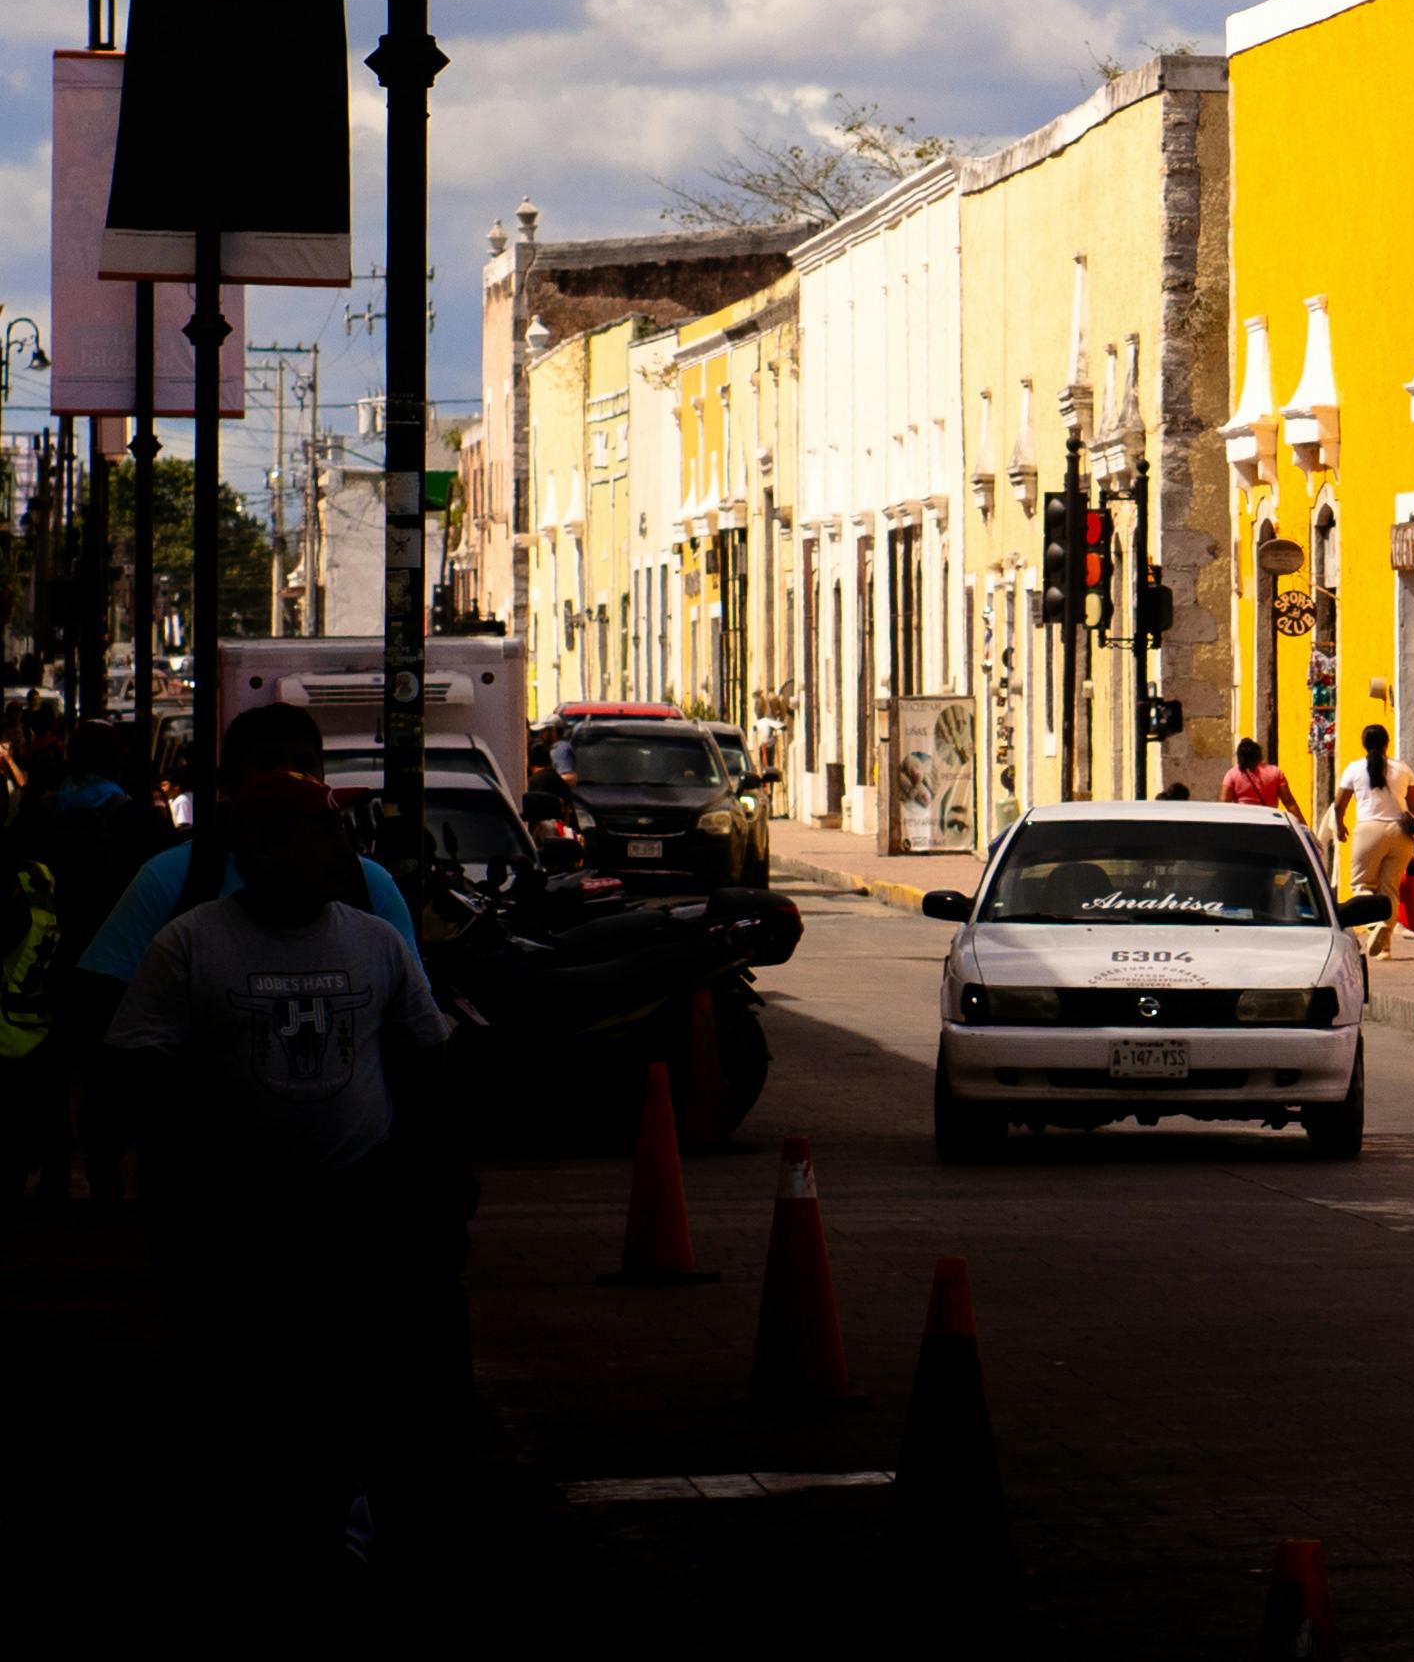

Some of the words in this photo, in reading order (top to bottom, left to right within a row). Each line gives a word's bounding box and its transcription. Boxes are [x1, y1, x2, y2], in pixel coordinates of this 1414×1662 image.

[1274, 592, 1314, 613] SPORT
[1277, 613, 1315, 634] CLUB
[1081, 891, 1224, 911] Anahisa
[1111, 950, 1195, 963] 6304
[256, 976, 300, 992] JOBES
[303, 975, 345, 991] HATS
